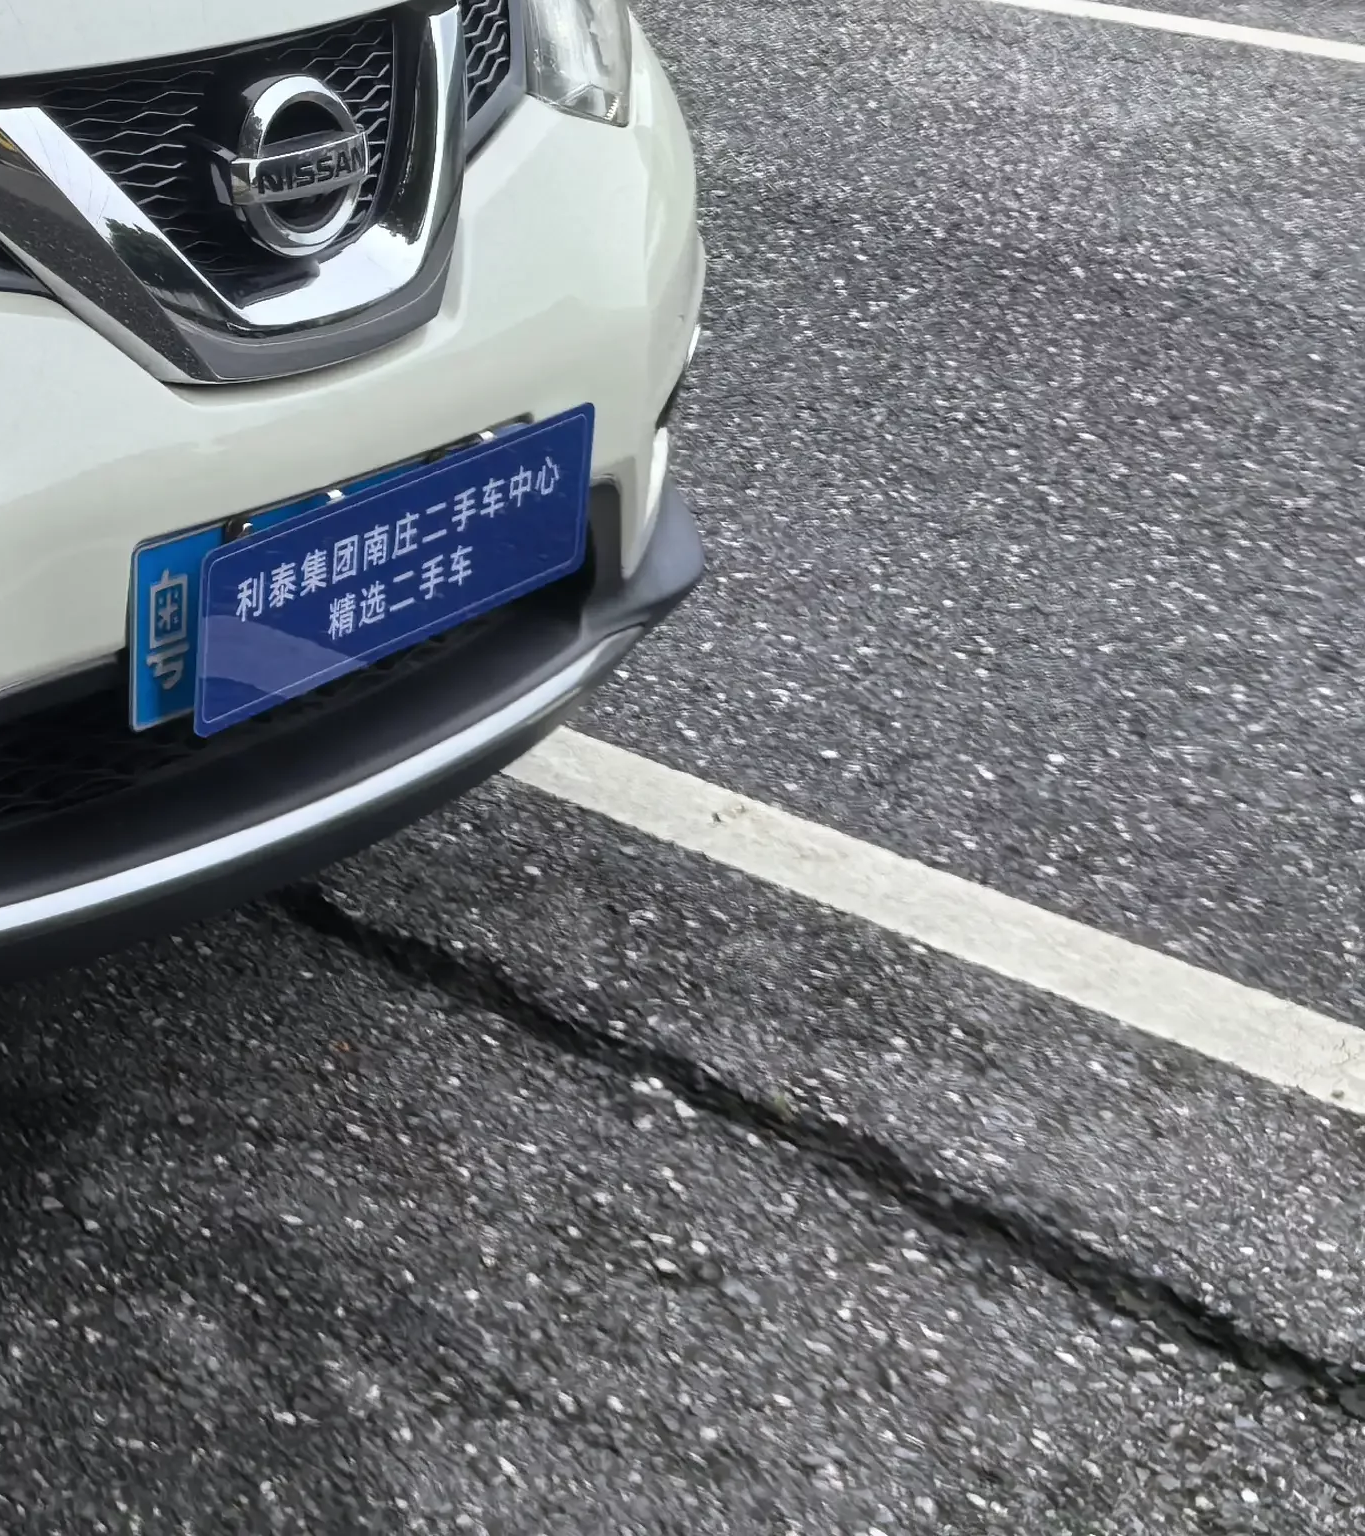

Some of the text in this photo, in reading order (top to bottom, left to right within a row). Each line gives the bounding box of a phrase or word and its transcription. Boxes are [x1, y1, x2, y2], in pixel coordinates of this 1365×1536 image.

[257, 146, 362, 195] NISSAN
[236, 456, 560, 622] 利泰集团南庄二手车中心
[328, 545, 474, 641] 精选二手车
[146, 569, 189, 691] 粤
